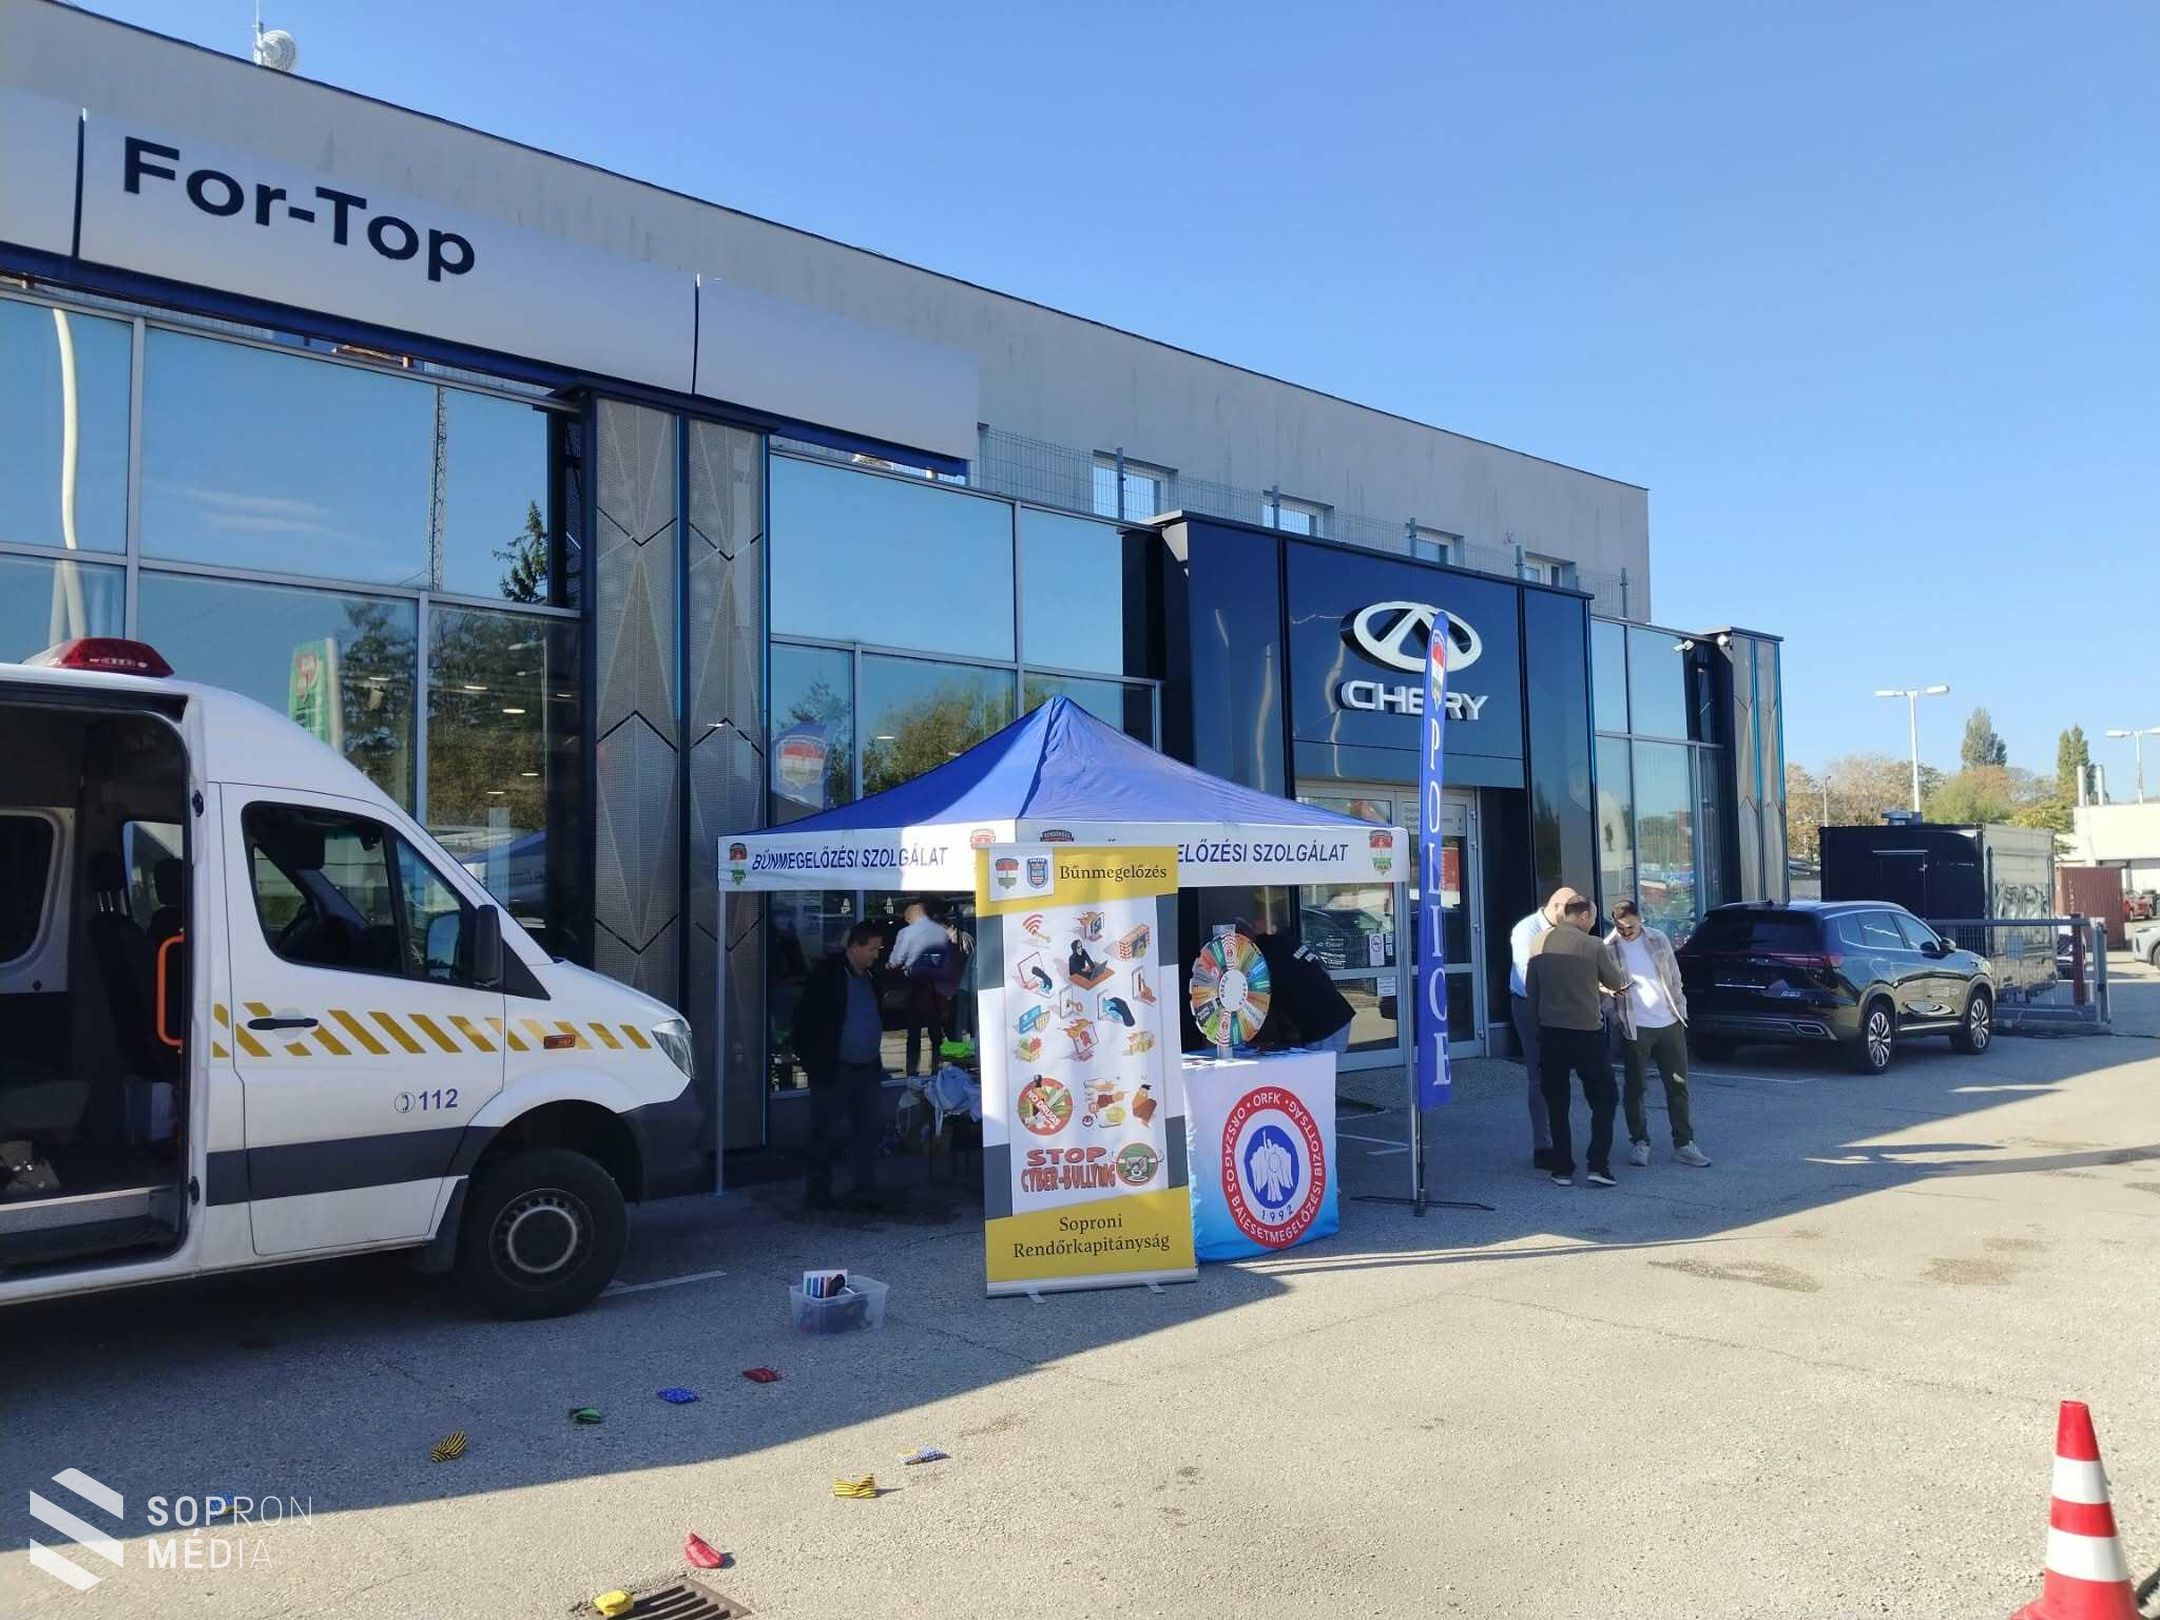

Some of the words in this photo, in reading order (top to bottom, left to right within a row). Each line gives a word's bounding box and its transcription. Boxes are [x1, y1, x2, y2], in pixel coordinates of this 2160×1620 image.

[124, 136, 475, 282] For-Top
[752, 846, 858, 870] BŰNMEGELŐZÉSI
[862, 844, 948, 868] SZOLGÁLAT
[1253, 840, 1349, 862] SZOLGÁLAT
[1060, 864, 1167, 882] Bűnmegelőzés
[1428, 718, 1451, 1085] POLICE
[419, 1088, 458, 1111] 112
[1253, 1092, 1281, 1107] ORFK
[1288, 1101, 1323, 1176] BIZOTTSÁG
[1027, 1146, 1107, 1167] STOP
[1060, 1213, 1123, 1234] Soproni
[1261, 1204, 1294, 1222] 1992
[1013, 1234, 1170, 1258] Rendőrkapitányság
